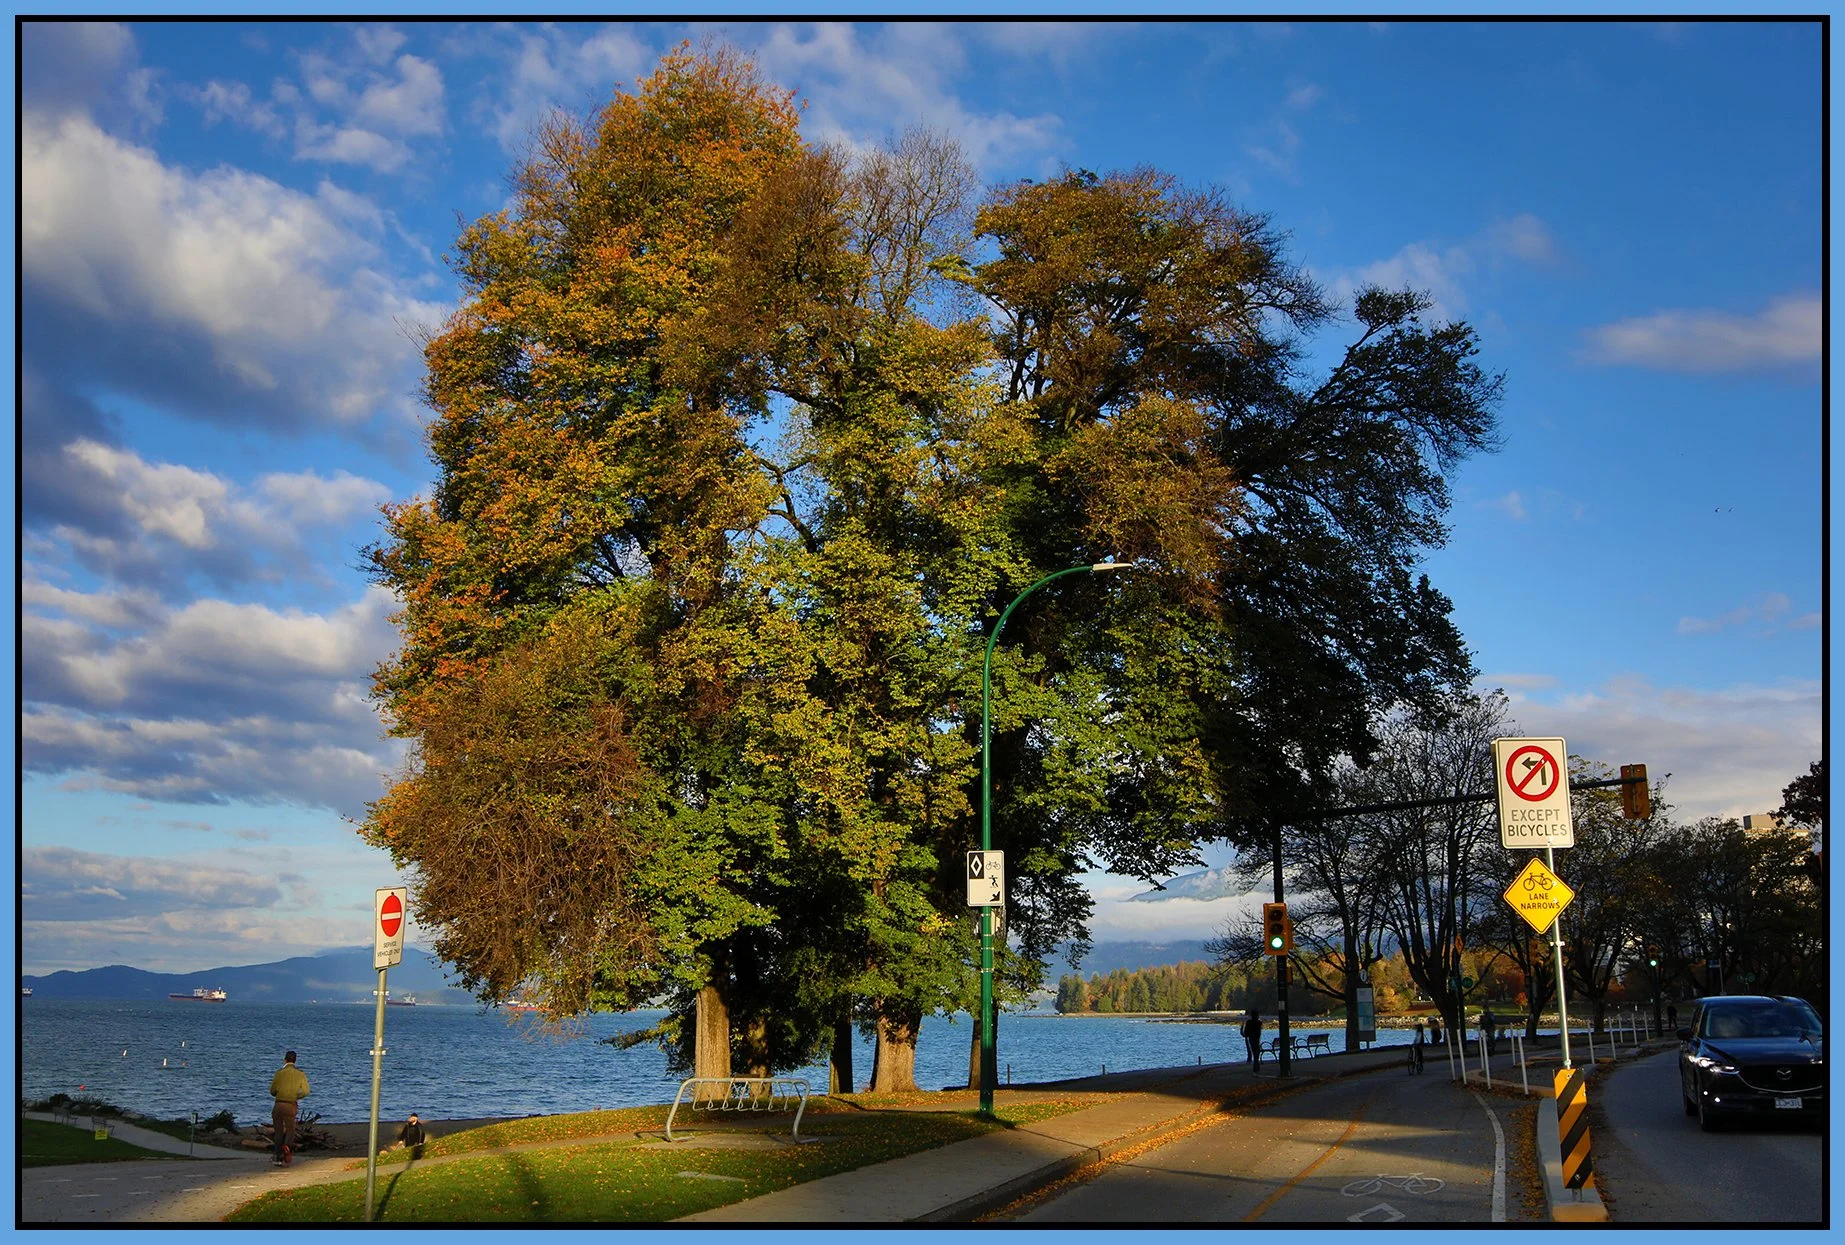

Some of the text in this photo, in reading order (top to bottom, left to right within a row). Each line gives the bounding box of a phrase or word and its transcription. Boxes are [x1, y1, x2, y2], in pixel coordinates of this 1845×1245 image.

[1511, 809, 1560, 821] EXCEPT
[1507, 824, 1567, 836] BICYCLES
[1529, 892, 1549, 901] LANE
[1520, 902, 1560, 910] NARROWS
